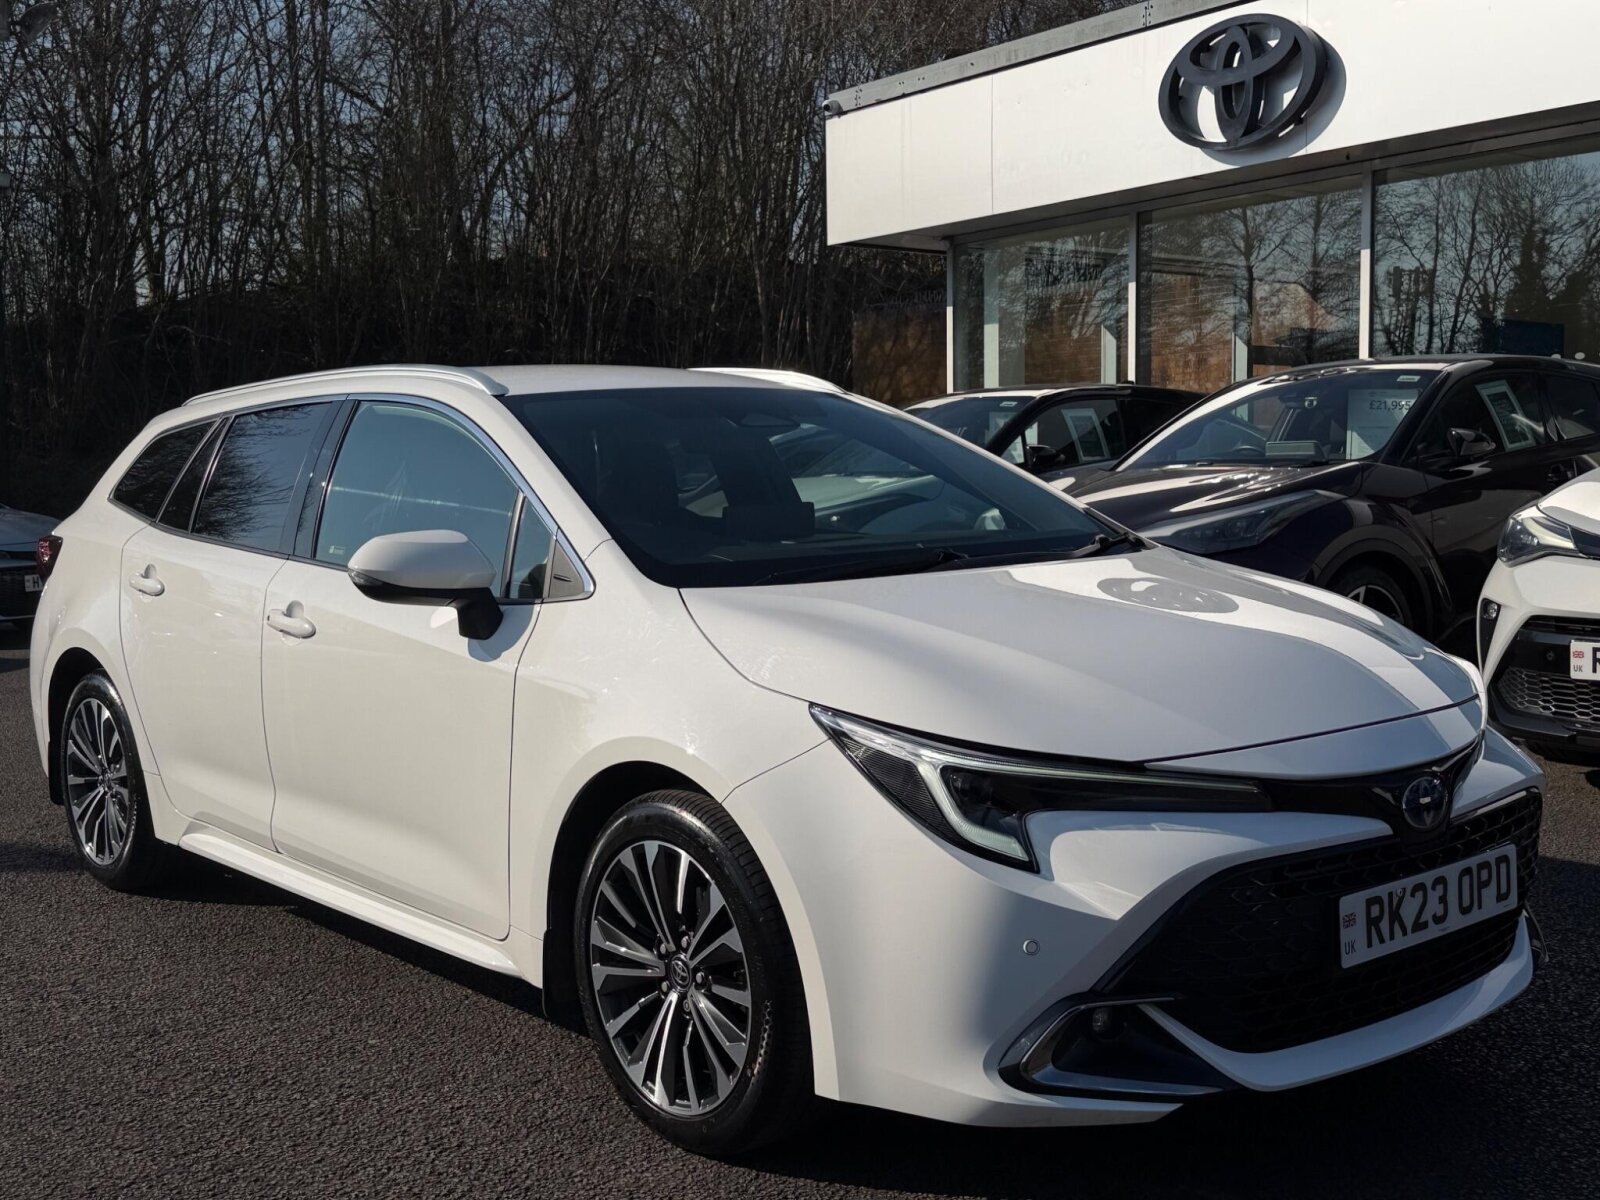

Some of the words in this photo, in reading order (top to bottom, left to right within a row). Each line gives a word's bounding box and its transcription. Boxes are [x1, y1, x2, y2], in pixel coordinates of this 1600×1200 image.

[1369, 400, 1411, 411] £21,995
[1573, 665, 1583, 673] UK
[1365, 875, 1449, 949] RK23
[1457, 854, 1511, 916] OPD
[1344, 939, 1357, 956] UK
